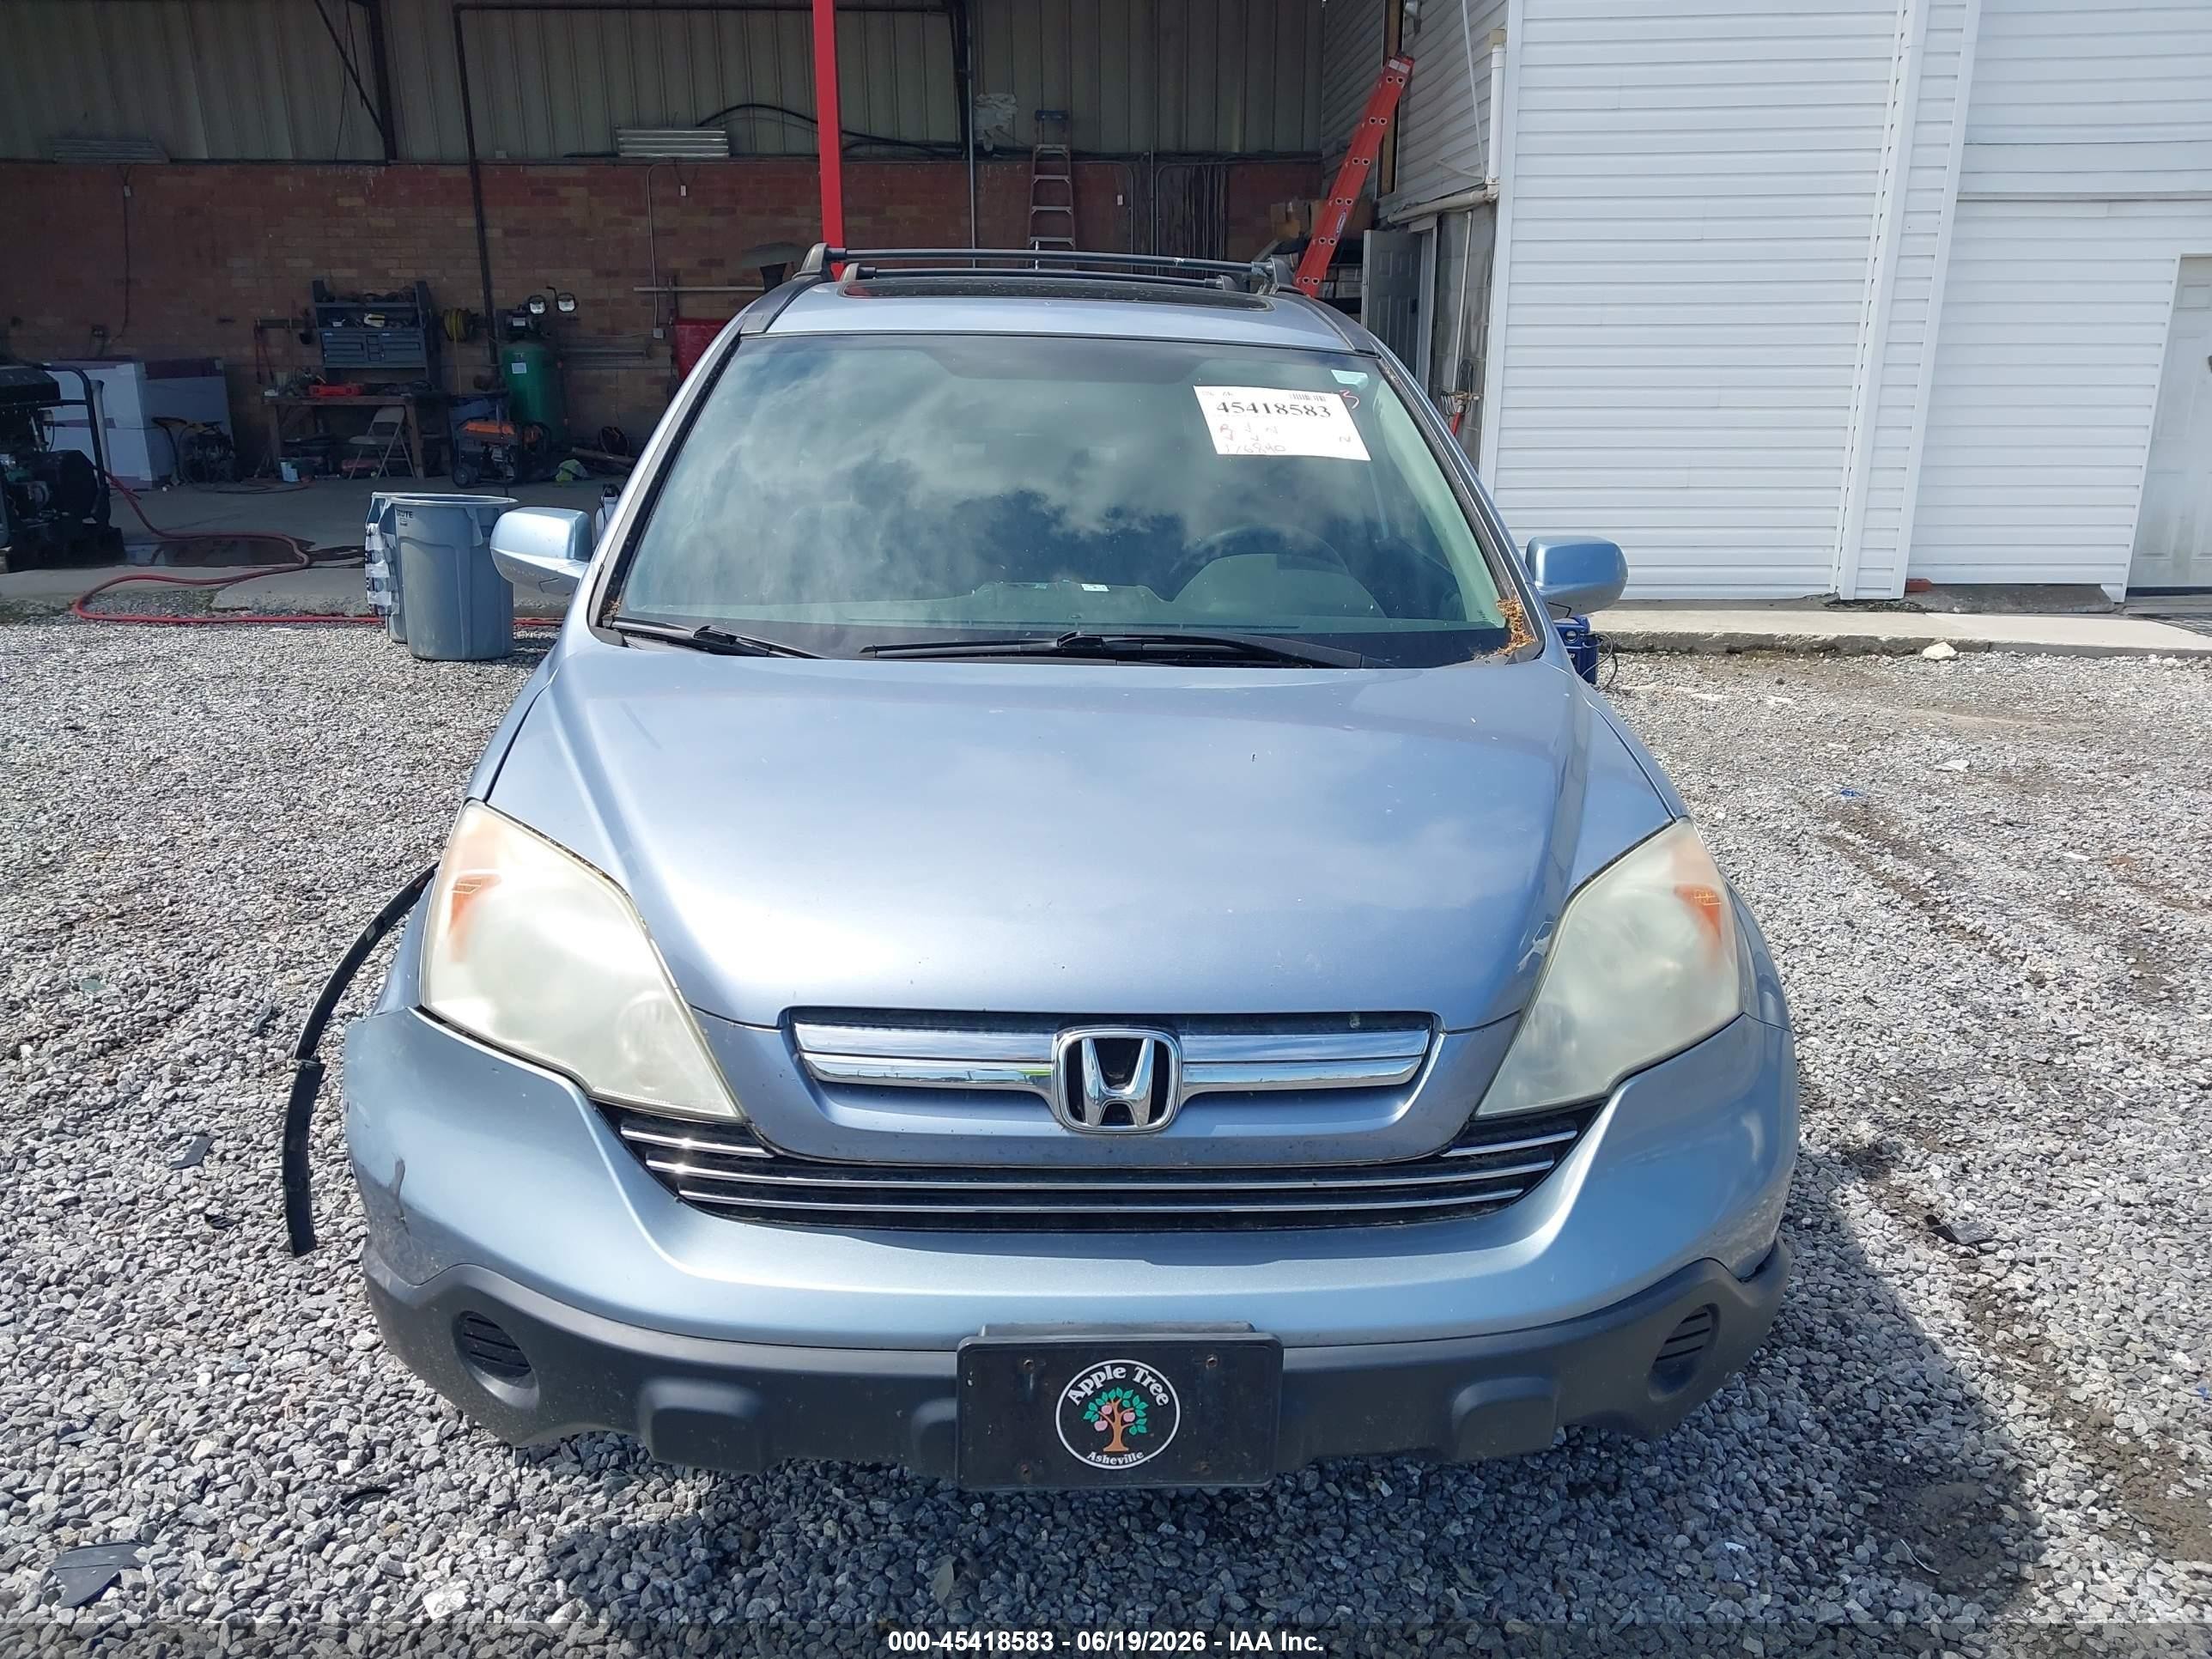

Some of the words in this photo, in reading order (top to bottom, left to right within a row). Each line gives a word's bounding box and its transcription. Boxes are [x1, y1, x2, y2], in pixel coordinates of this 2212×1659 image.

[1216, 401, 1332, 418] 45418583
[1066, 1364, 1127, 1407] Apple
[1133, 1365, 1170, 1407] Tree
[1086, 1449, 1144, 1466] Asheville
